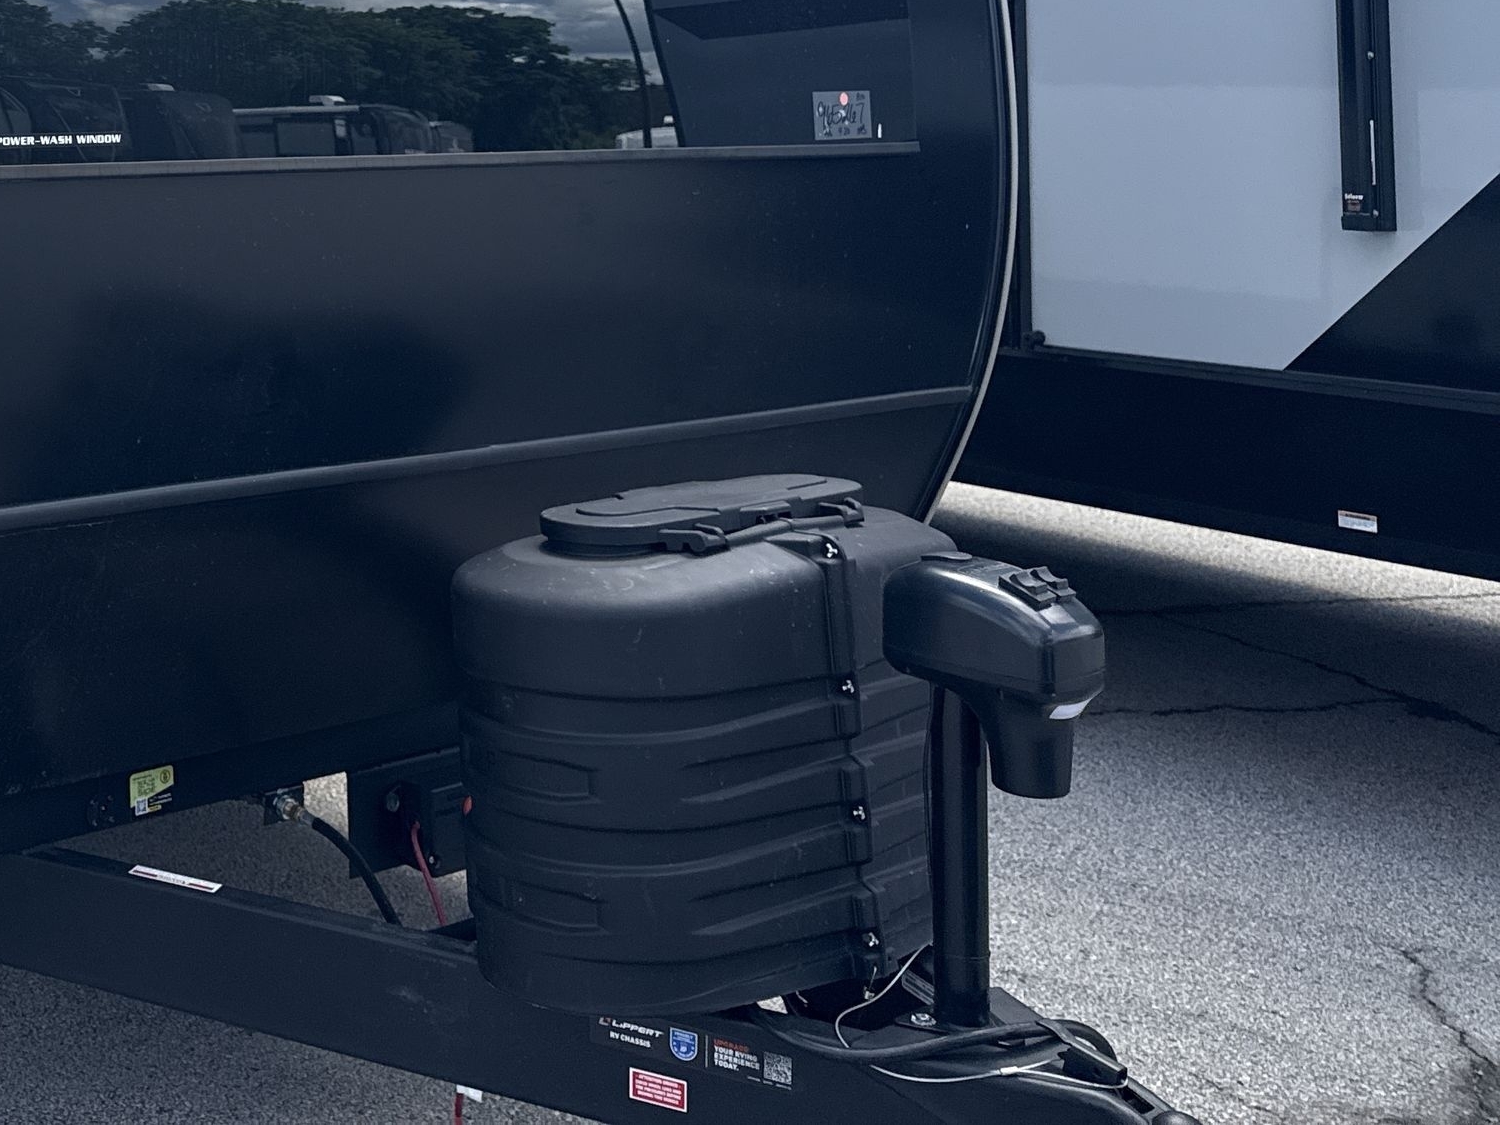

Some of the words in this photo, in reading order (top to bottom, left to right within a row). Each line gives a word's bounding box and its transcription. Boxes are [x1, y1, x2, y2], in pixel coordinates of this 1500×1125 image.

[76, 133, 122, 145] WINDOW
[611, 1019, 665, 1038] LIPPERT
[609, 1030, 619, 1040] RV
[620, 1033, 651, 1049] CHASSIS
[714, 1045, 734, 1056] YOUR
[713, 1052, 760, 1070] EXPERIENCE
